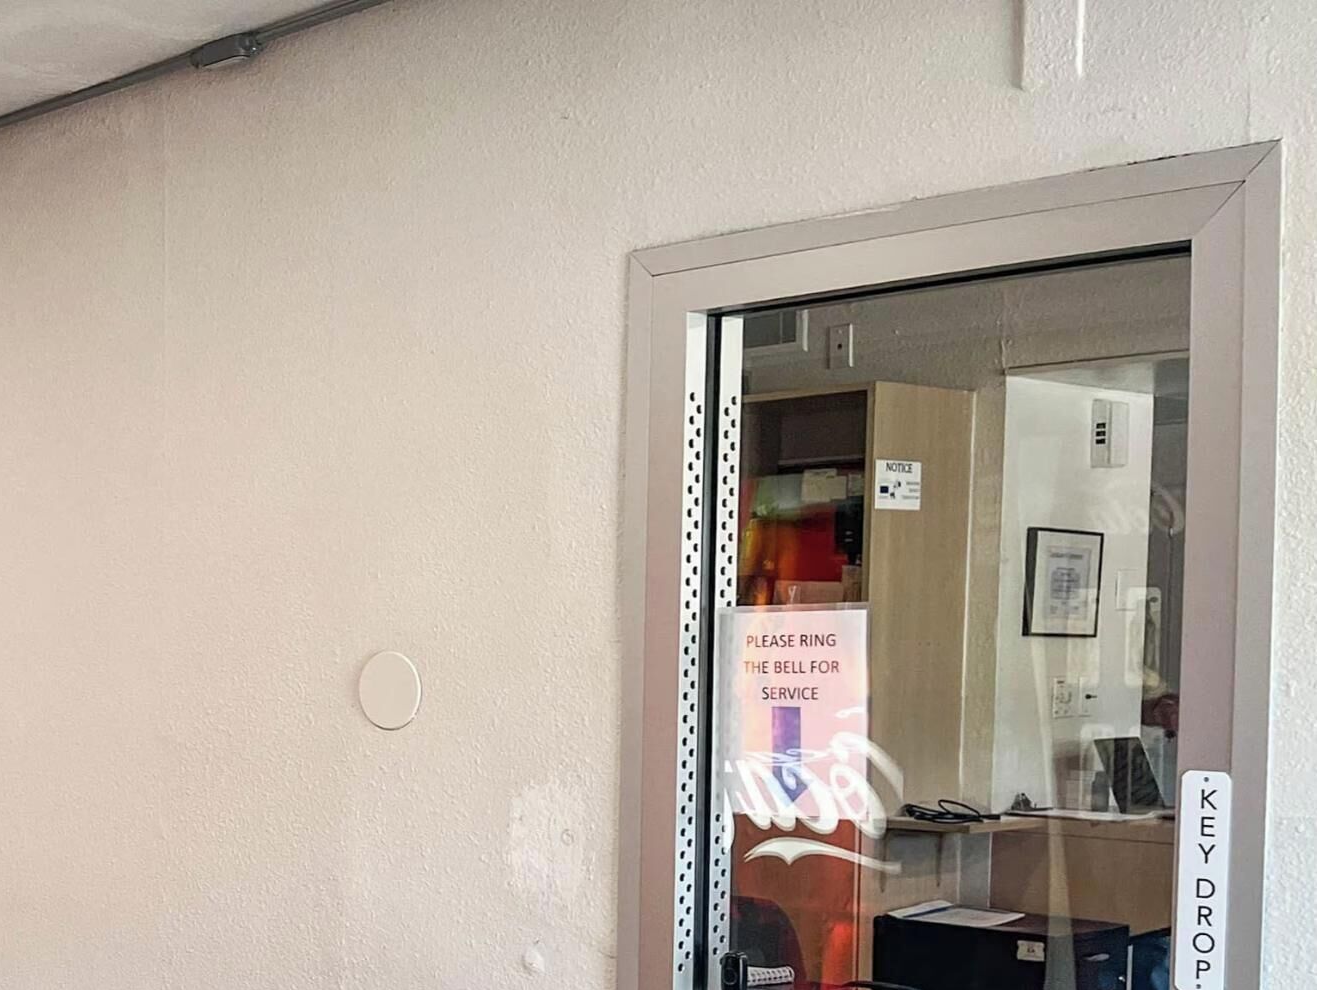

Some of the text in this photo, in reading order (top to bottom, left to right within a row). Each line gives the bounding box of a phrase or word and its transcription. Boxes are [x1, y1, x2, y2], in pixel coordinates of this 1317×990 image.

[885, 462, 913, 473] NOTICE
[746, 633, 837, 648] PLEASE RING
[743, 660, 840, 674] THE BELL FOR
[761, 687, 819, 700] SERVICE
[1192, 788, 1218, 980] KEY DROP
